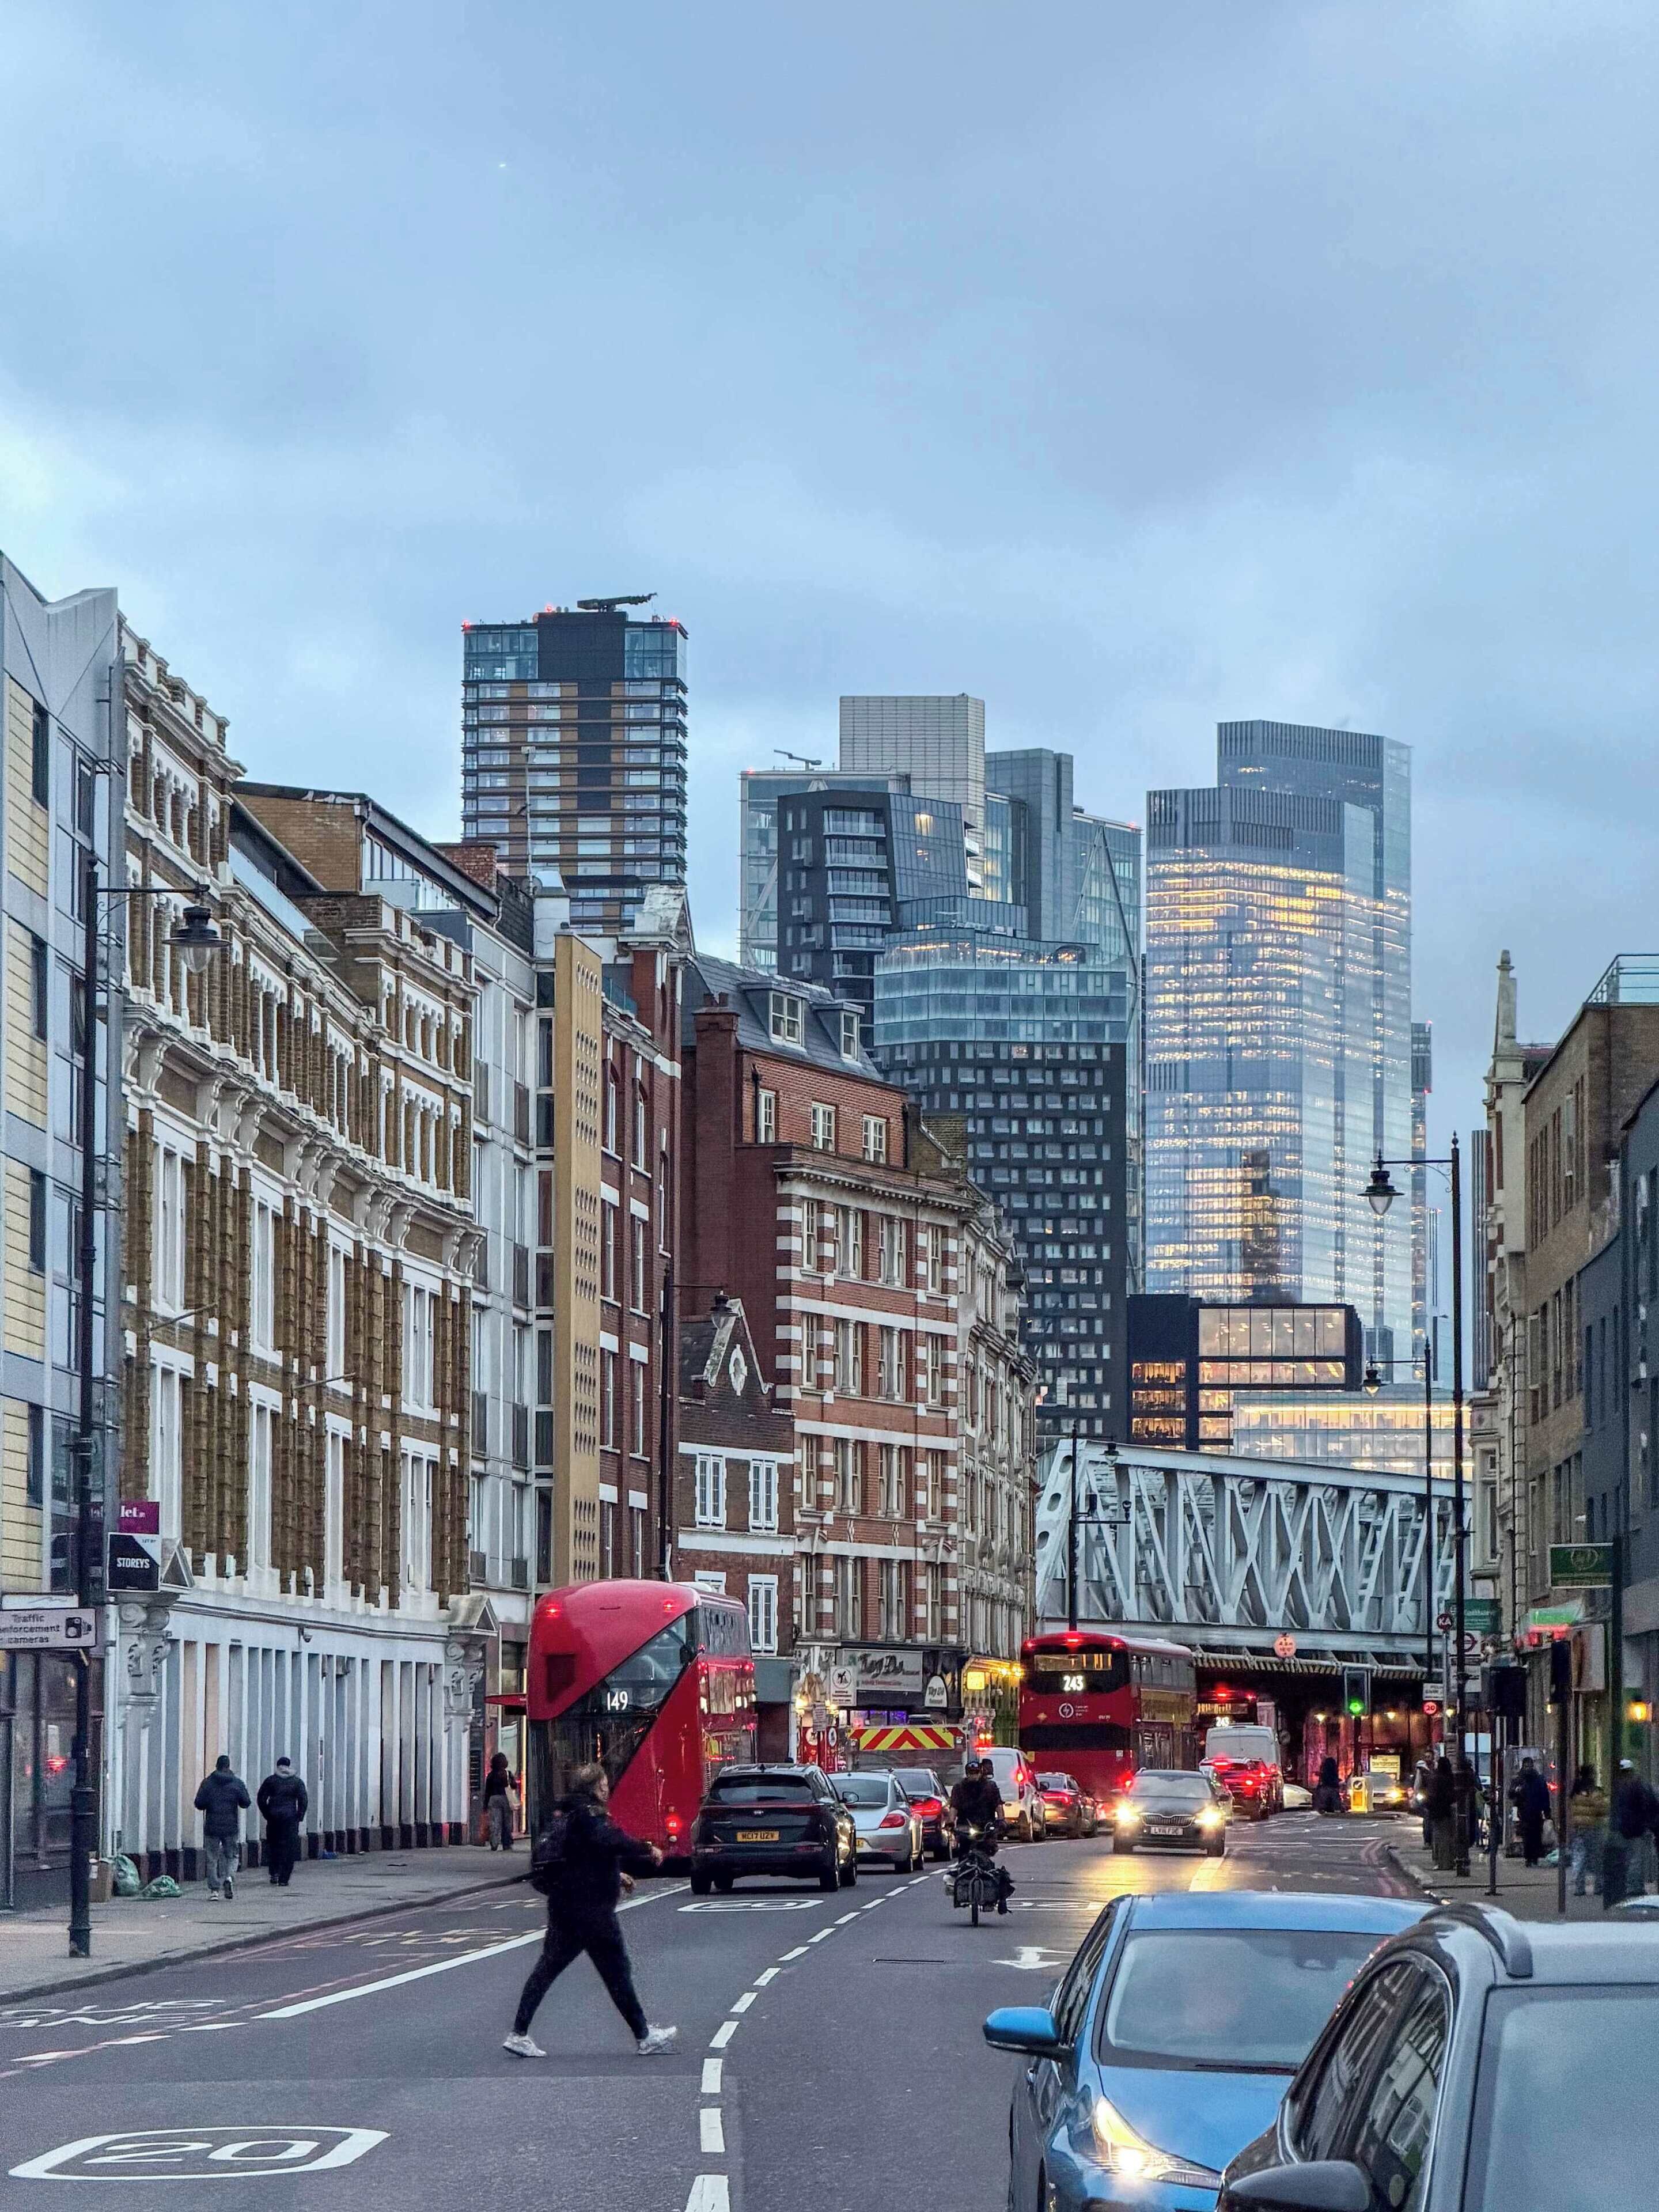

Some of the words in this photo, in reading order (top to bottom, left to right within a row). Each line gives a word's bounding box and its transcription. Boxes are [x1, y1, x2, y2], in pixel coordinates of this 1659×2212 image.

[117, 1558, 150, 1569] STOREYS
[12, 1613, 45, 1623] Traffic
[0, 1624, 60, 1634] nforcement
[1063, 1675, 1084, 1691] 243
[607, 1691, 628, 1711] 149
[82, 2140, 321, 2164] 20
